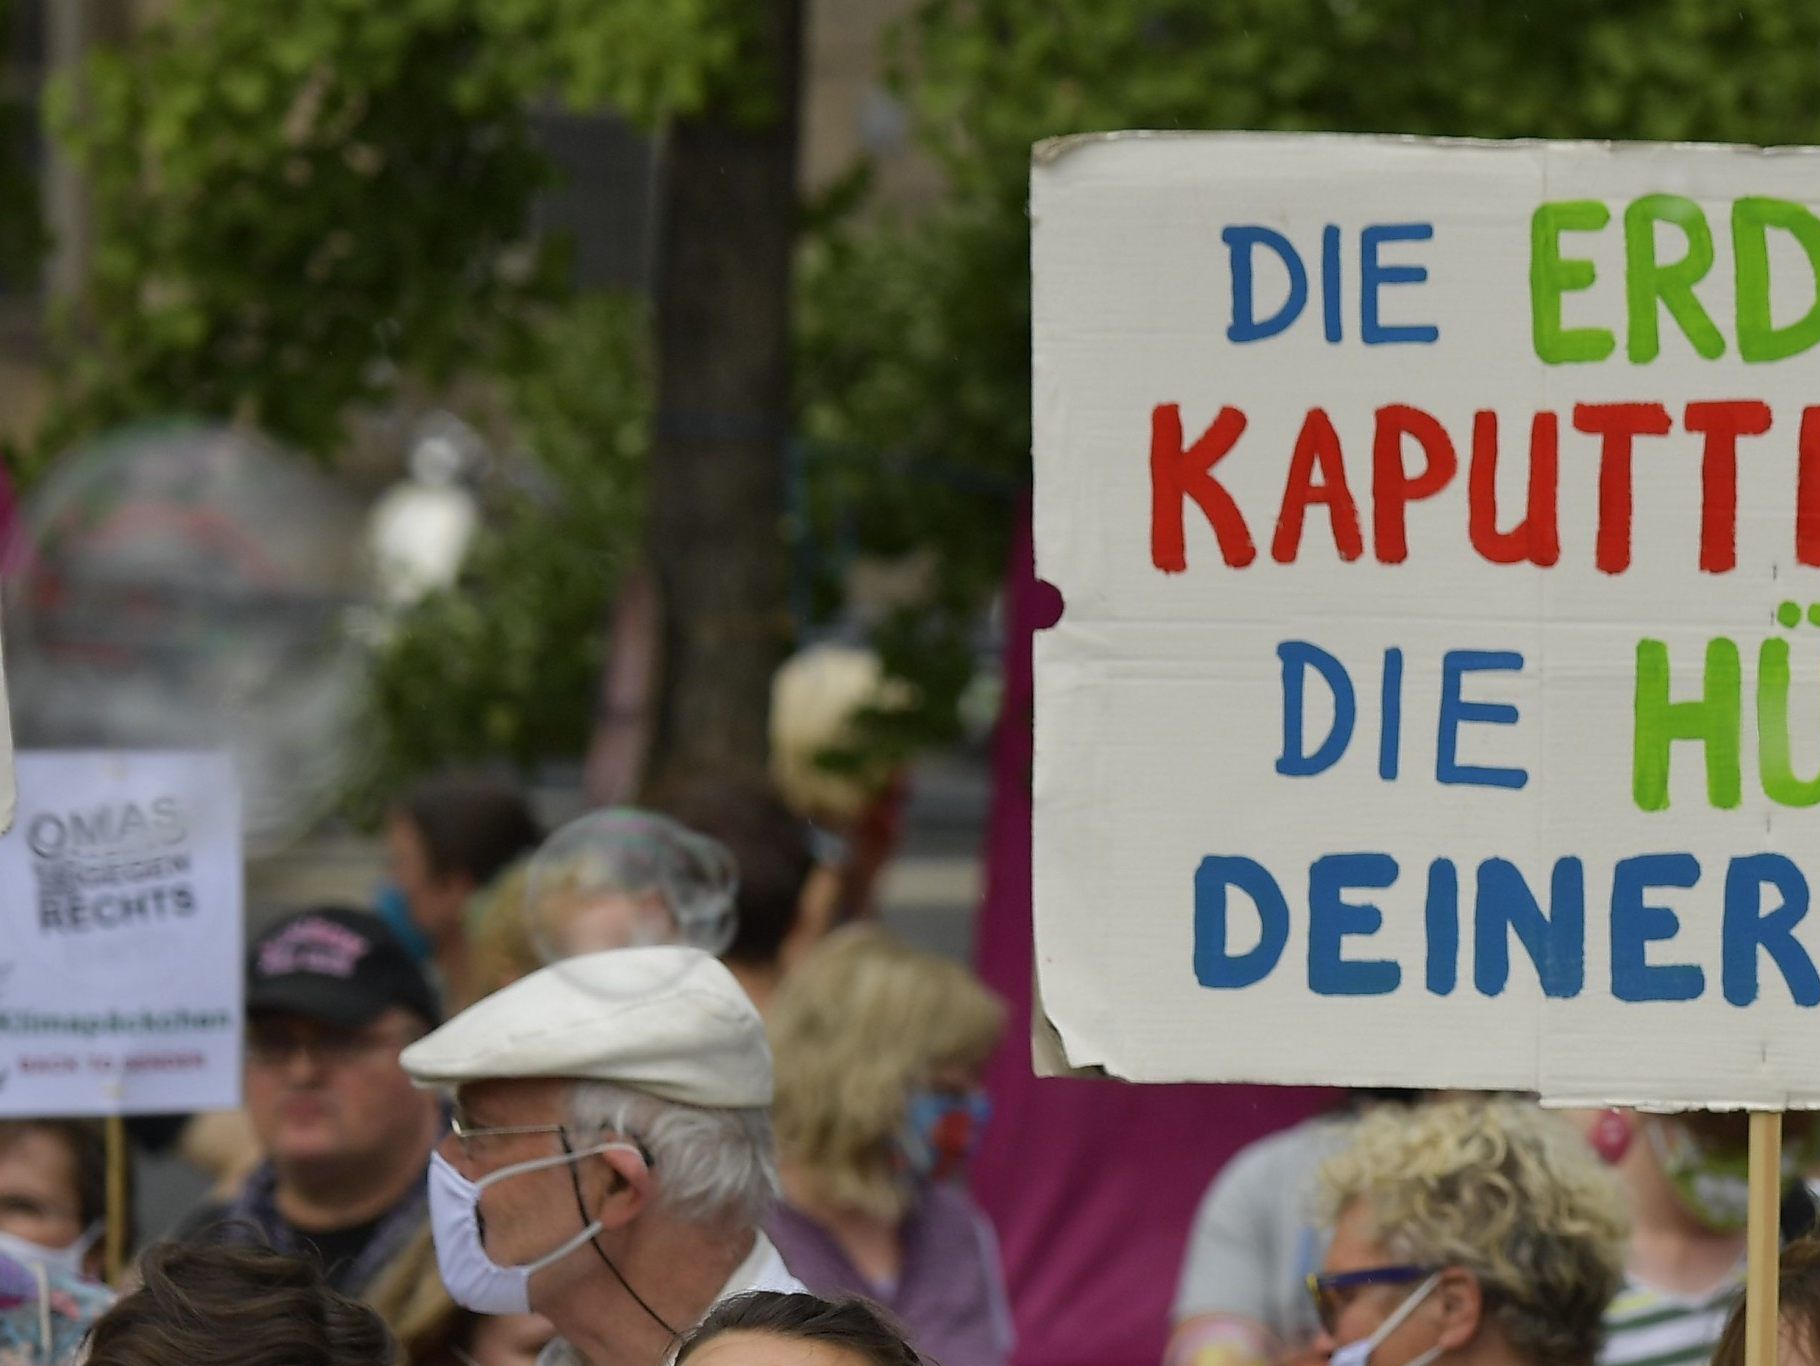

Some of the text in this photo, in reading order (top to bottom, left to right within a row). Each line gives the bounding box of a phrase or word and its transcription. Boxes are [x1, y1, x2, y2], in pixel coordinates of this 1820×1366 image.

[1222, 222, 1439, 345] DIE
[1275, 640, 1528, 789] DIE
[27, 798, 189, 860] OMAS
[39, 882, 196, 935] RECHTS
